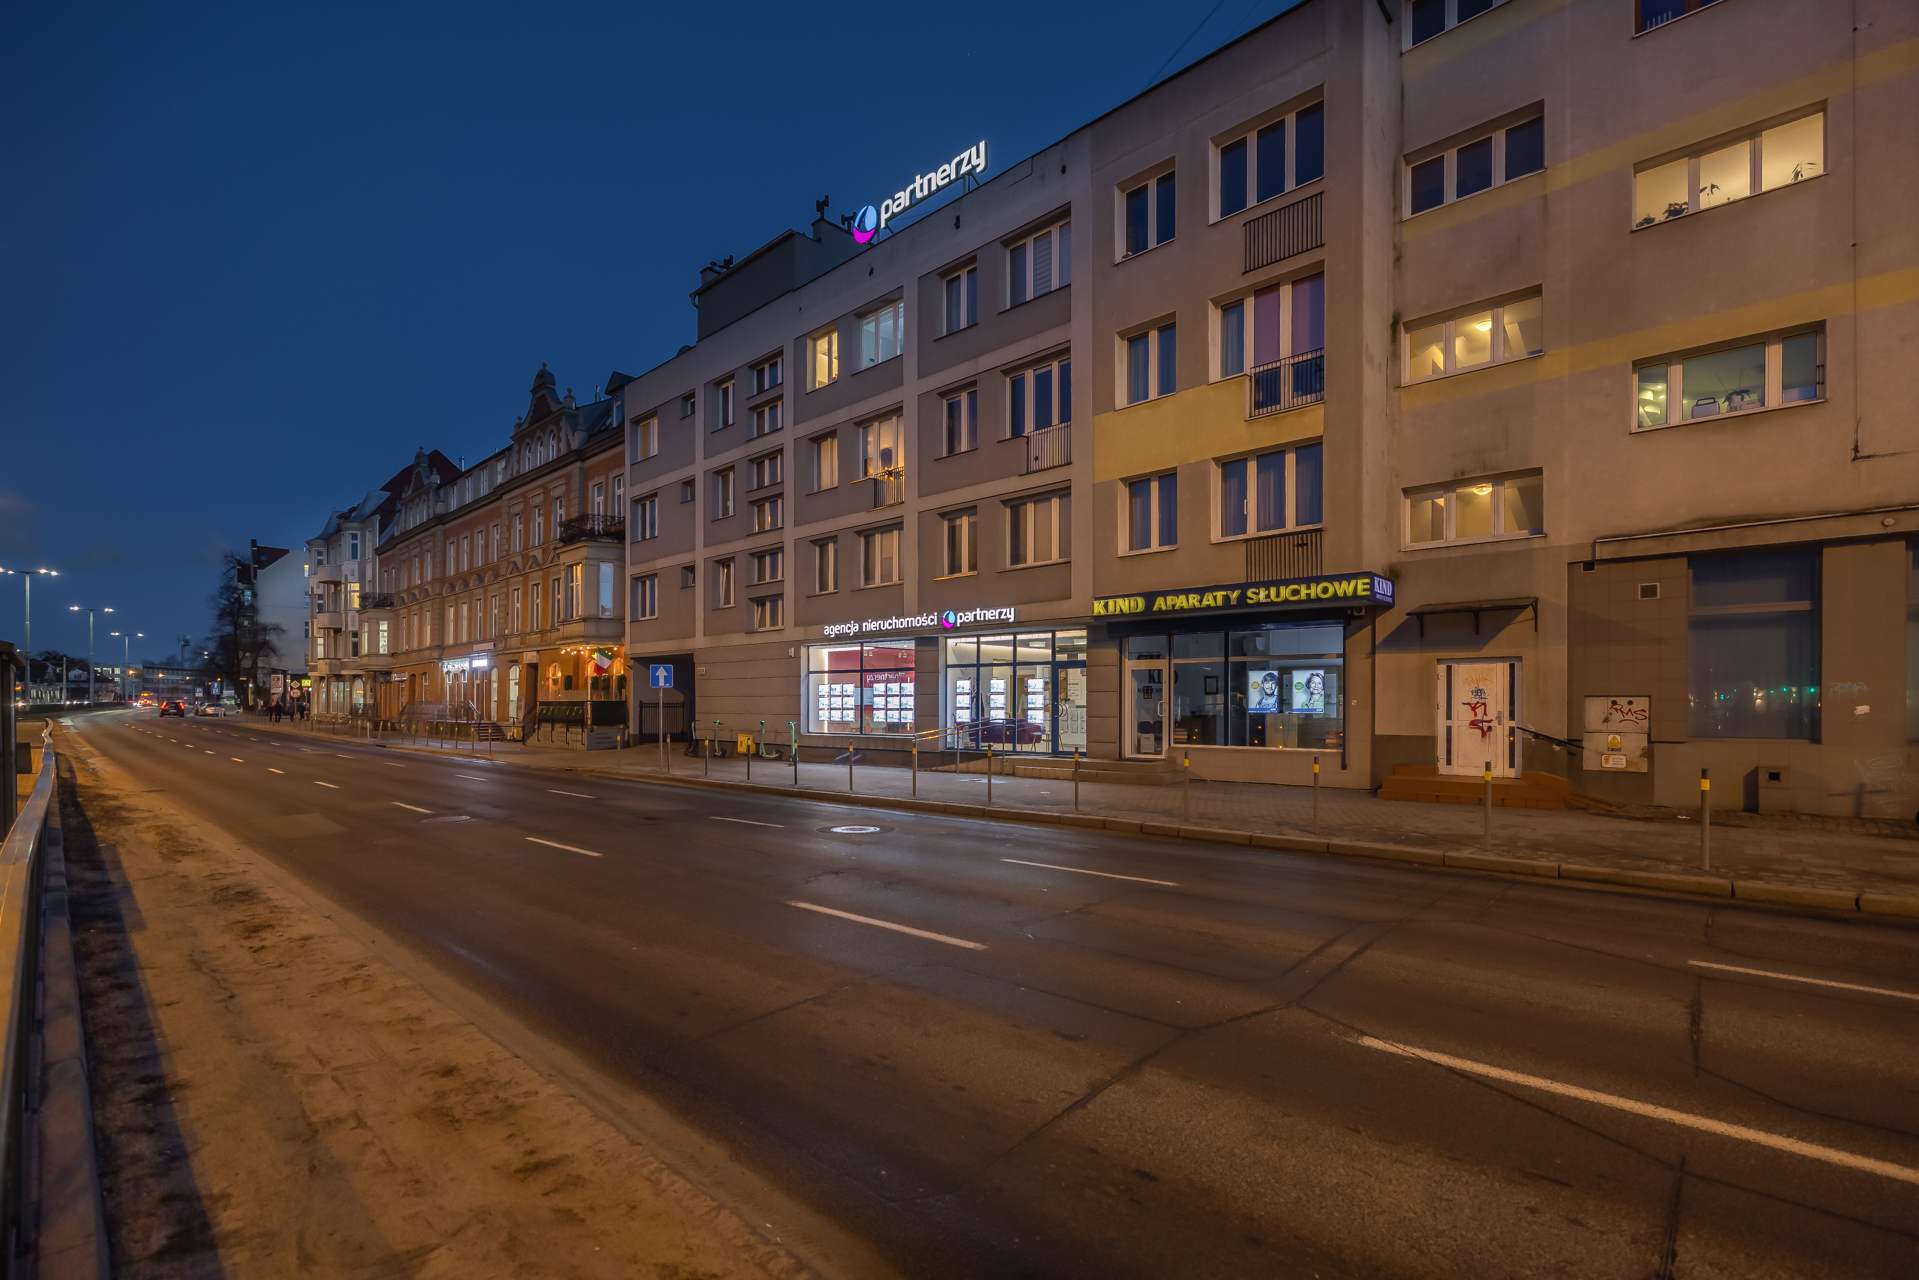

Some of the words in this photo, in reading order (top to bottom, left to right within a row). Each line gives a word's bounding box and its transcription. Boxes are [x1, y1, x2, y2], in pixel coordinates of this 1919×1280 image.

[880, 140, 987, 229] partnerzy
[1093, 596, 1145, 616] KIND
[1152, 589, 1241, 612] APARATY
[1246, 578, 1370, 605] SŁUCHOWE
[1374, 576, 1392, 596] KIND
[824, 621, 859, 638] agencja
[862, 611, 938, 632] nieruchomości
[956, 607, 1015, 627] partnerzy
